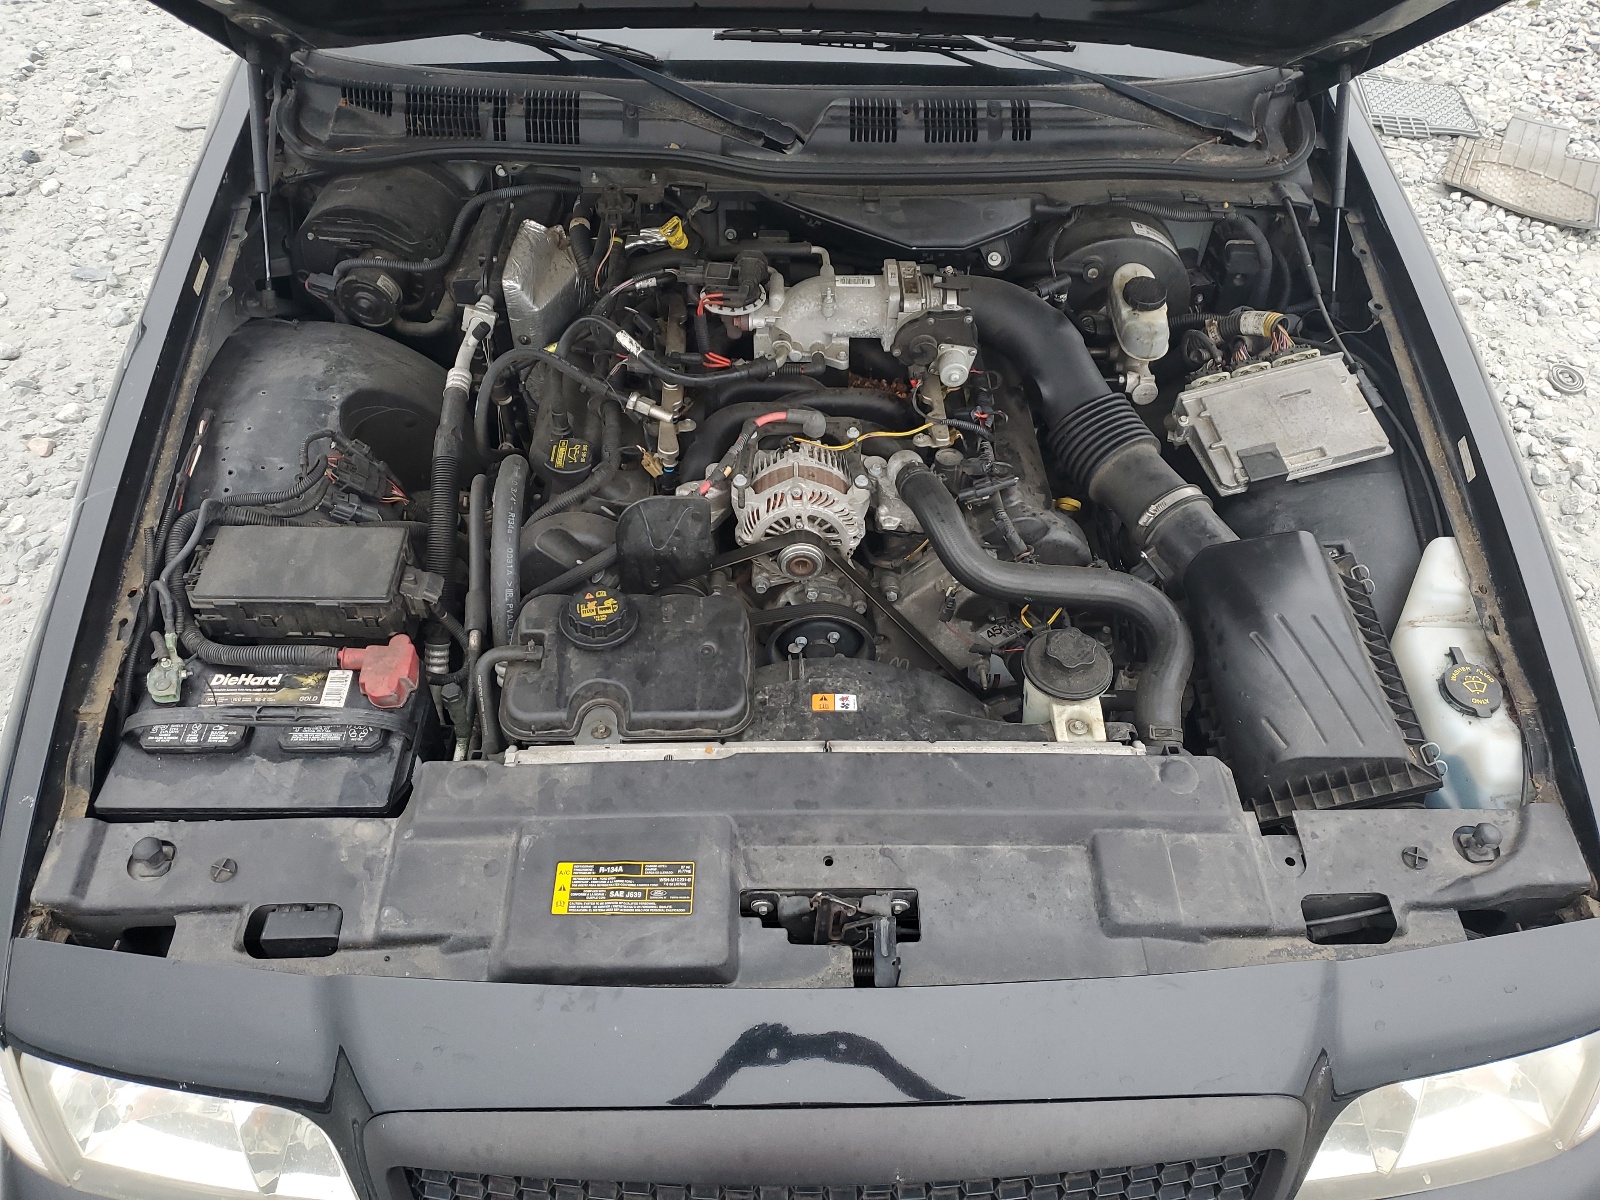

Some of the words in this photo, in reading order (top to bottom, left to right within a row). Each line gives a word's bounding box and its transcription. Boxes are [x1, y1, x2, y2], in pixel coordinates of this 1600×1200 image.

[210, 673, 283, 686] DieHard
[1471, 697, 1489, 705] ONLY
[599, 866, 624, 874] R-134A
[609, 890, 625, 898] SAE
